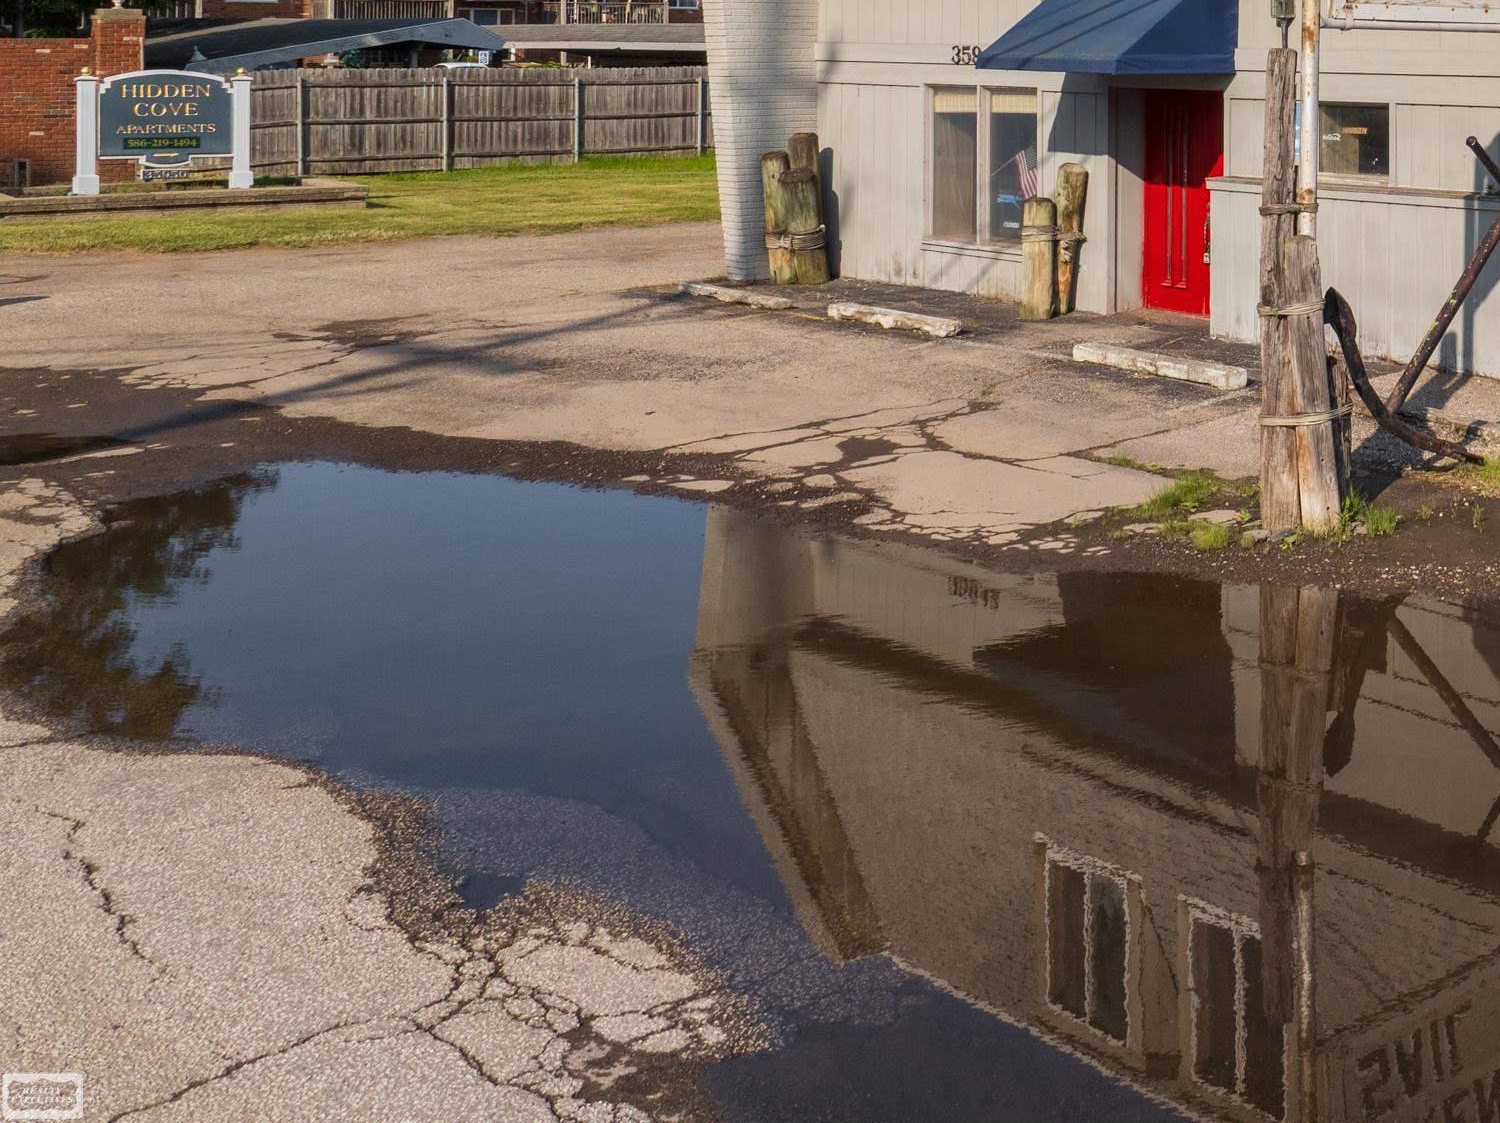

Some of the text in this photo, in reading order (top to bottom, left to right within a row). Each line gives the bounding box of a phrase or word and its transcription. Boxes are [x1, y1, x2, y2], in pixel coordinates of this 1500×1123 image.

[121, 84, 211, 98] HIDDEN
[133, 102, 199, 117] COVE
[116, 123, 216, 134] APARTMENTS
[127, 138, 197, 147] 586-219-1494
